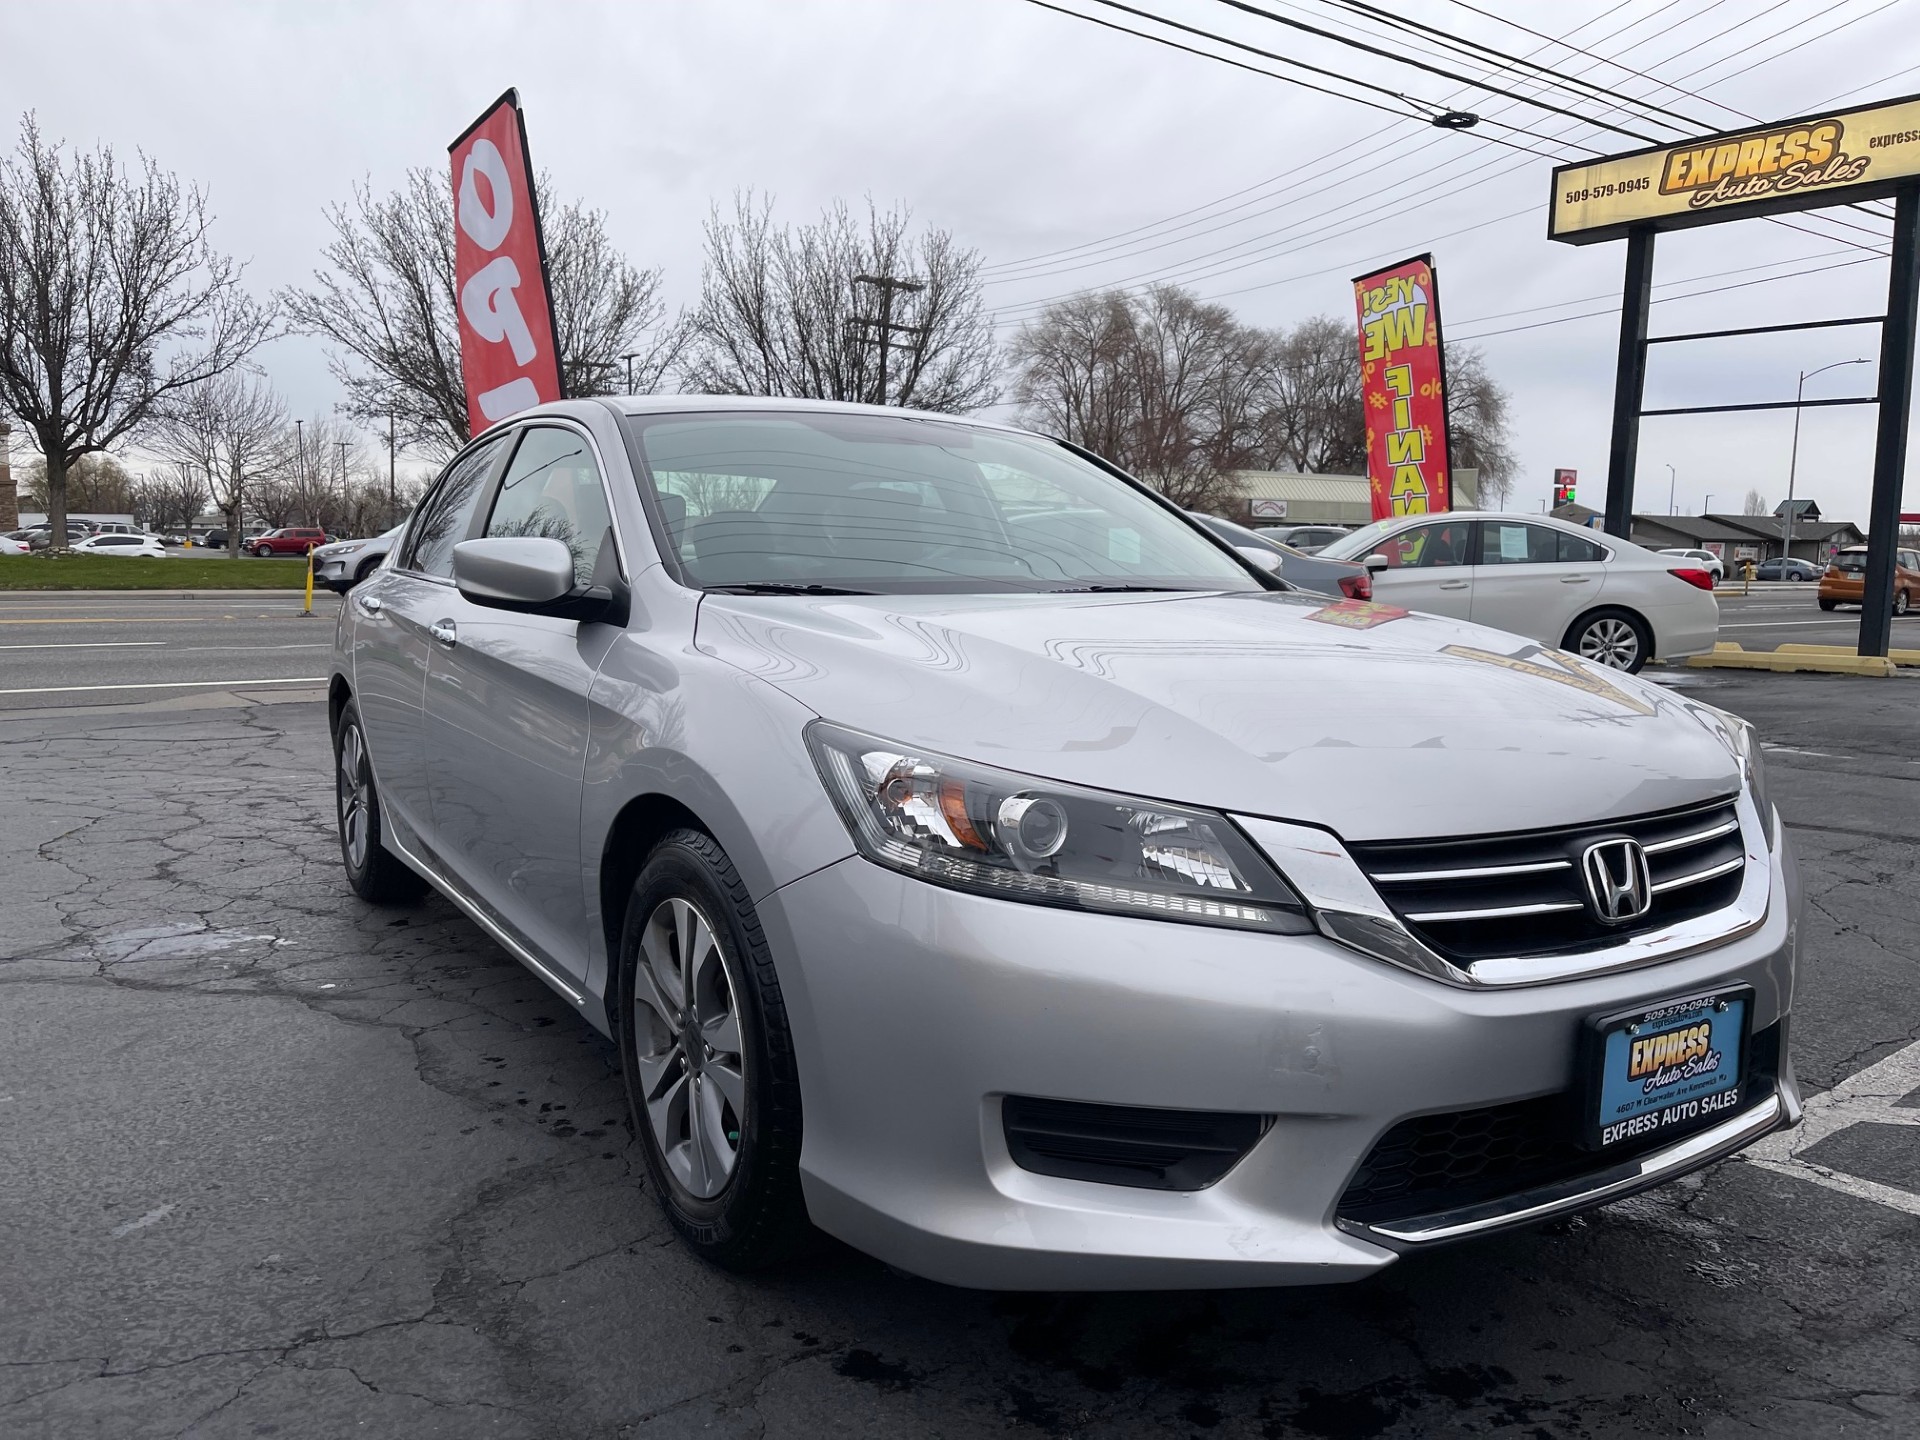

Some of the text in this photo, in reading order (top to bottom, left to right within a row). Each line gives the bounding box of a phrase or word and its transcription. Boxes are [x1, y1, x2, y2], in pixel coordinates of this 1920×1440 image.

[1663, 122, 1840, 193] EXPRESS
[1869, 130, 1920, 150] express
[1565, 177, 1650, 204] 509-579-0945
[1692, 155, 1867, 206] Auto Sales
[1643, 996, 1716, 1023] 509-579-0945
[1629, 1023, 1710, 1078] EXPRESS
[1644, 1049, 1721, 1093] Auto Sales
[1615, 1101, 1635, 1114] 4607
[1636, 1098, 1643, 1108] W
[1643, 1090, 1675, 1106] Clearwater
[1676, 1087, 1688, 1097] Ave
[1688, 1076, 1717, 1093] Kennewick
[1602, 1089, 1738, 1146] EXPRESS AUTO SALES
